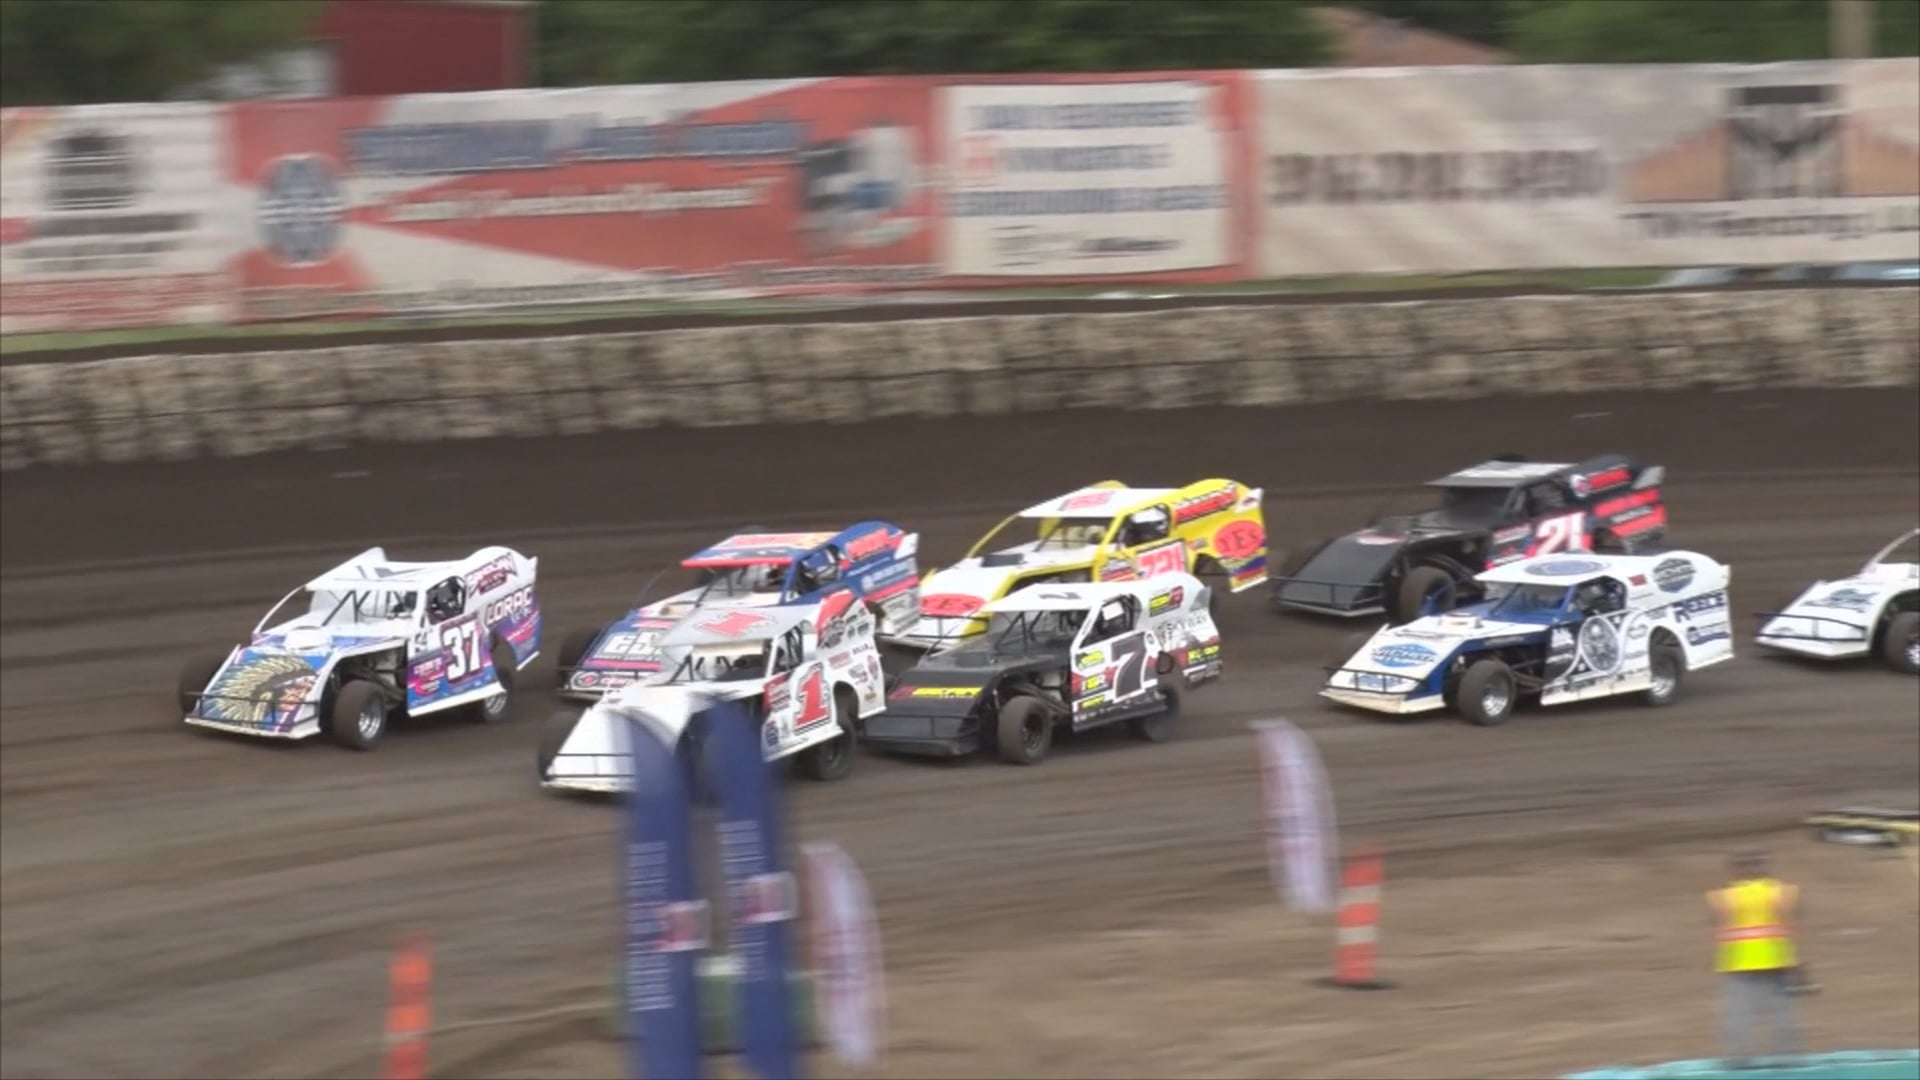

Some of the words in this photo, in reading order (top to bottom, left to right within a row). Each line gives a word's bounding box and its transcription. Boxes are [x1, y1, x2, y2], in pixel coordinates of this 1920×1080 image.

[1672, 592, 1726, 623] REECE
[442, 620, 481, 681] 37
[1110, 632, 1147, 701] 7
[794, 666, 831, 729] 1
